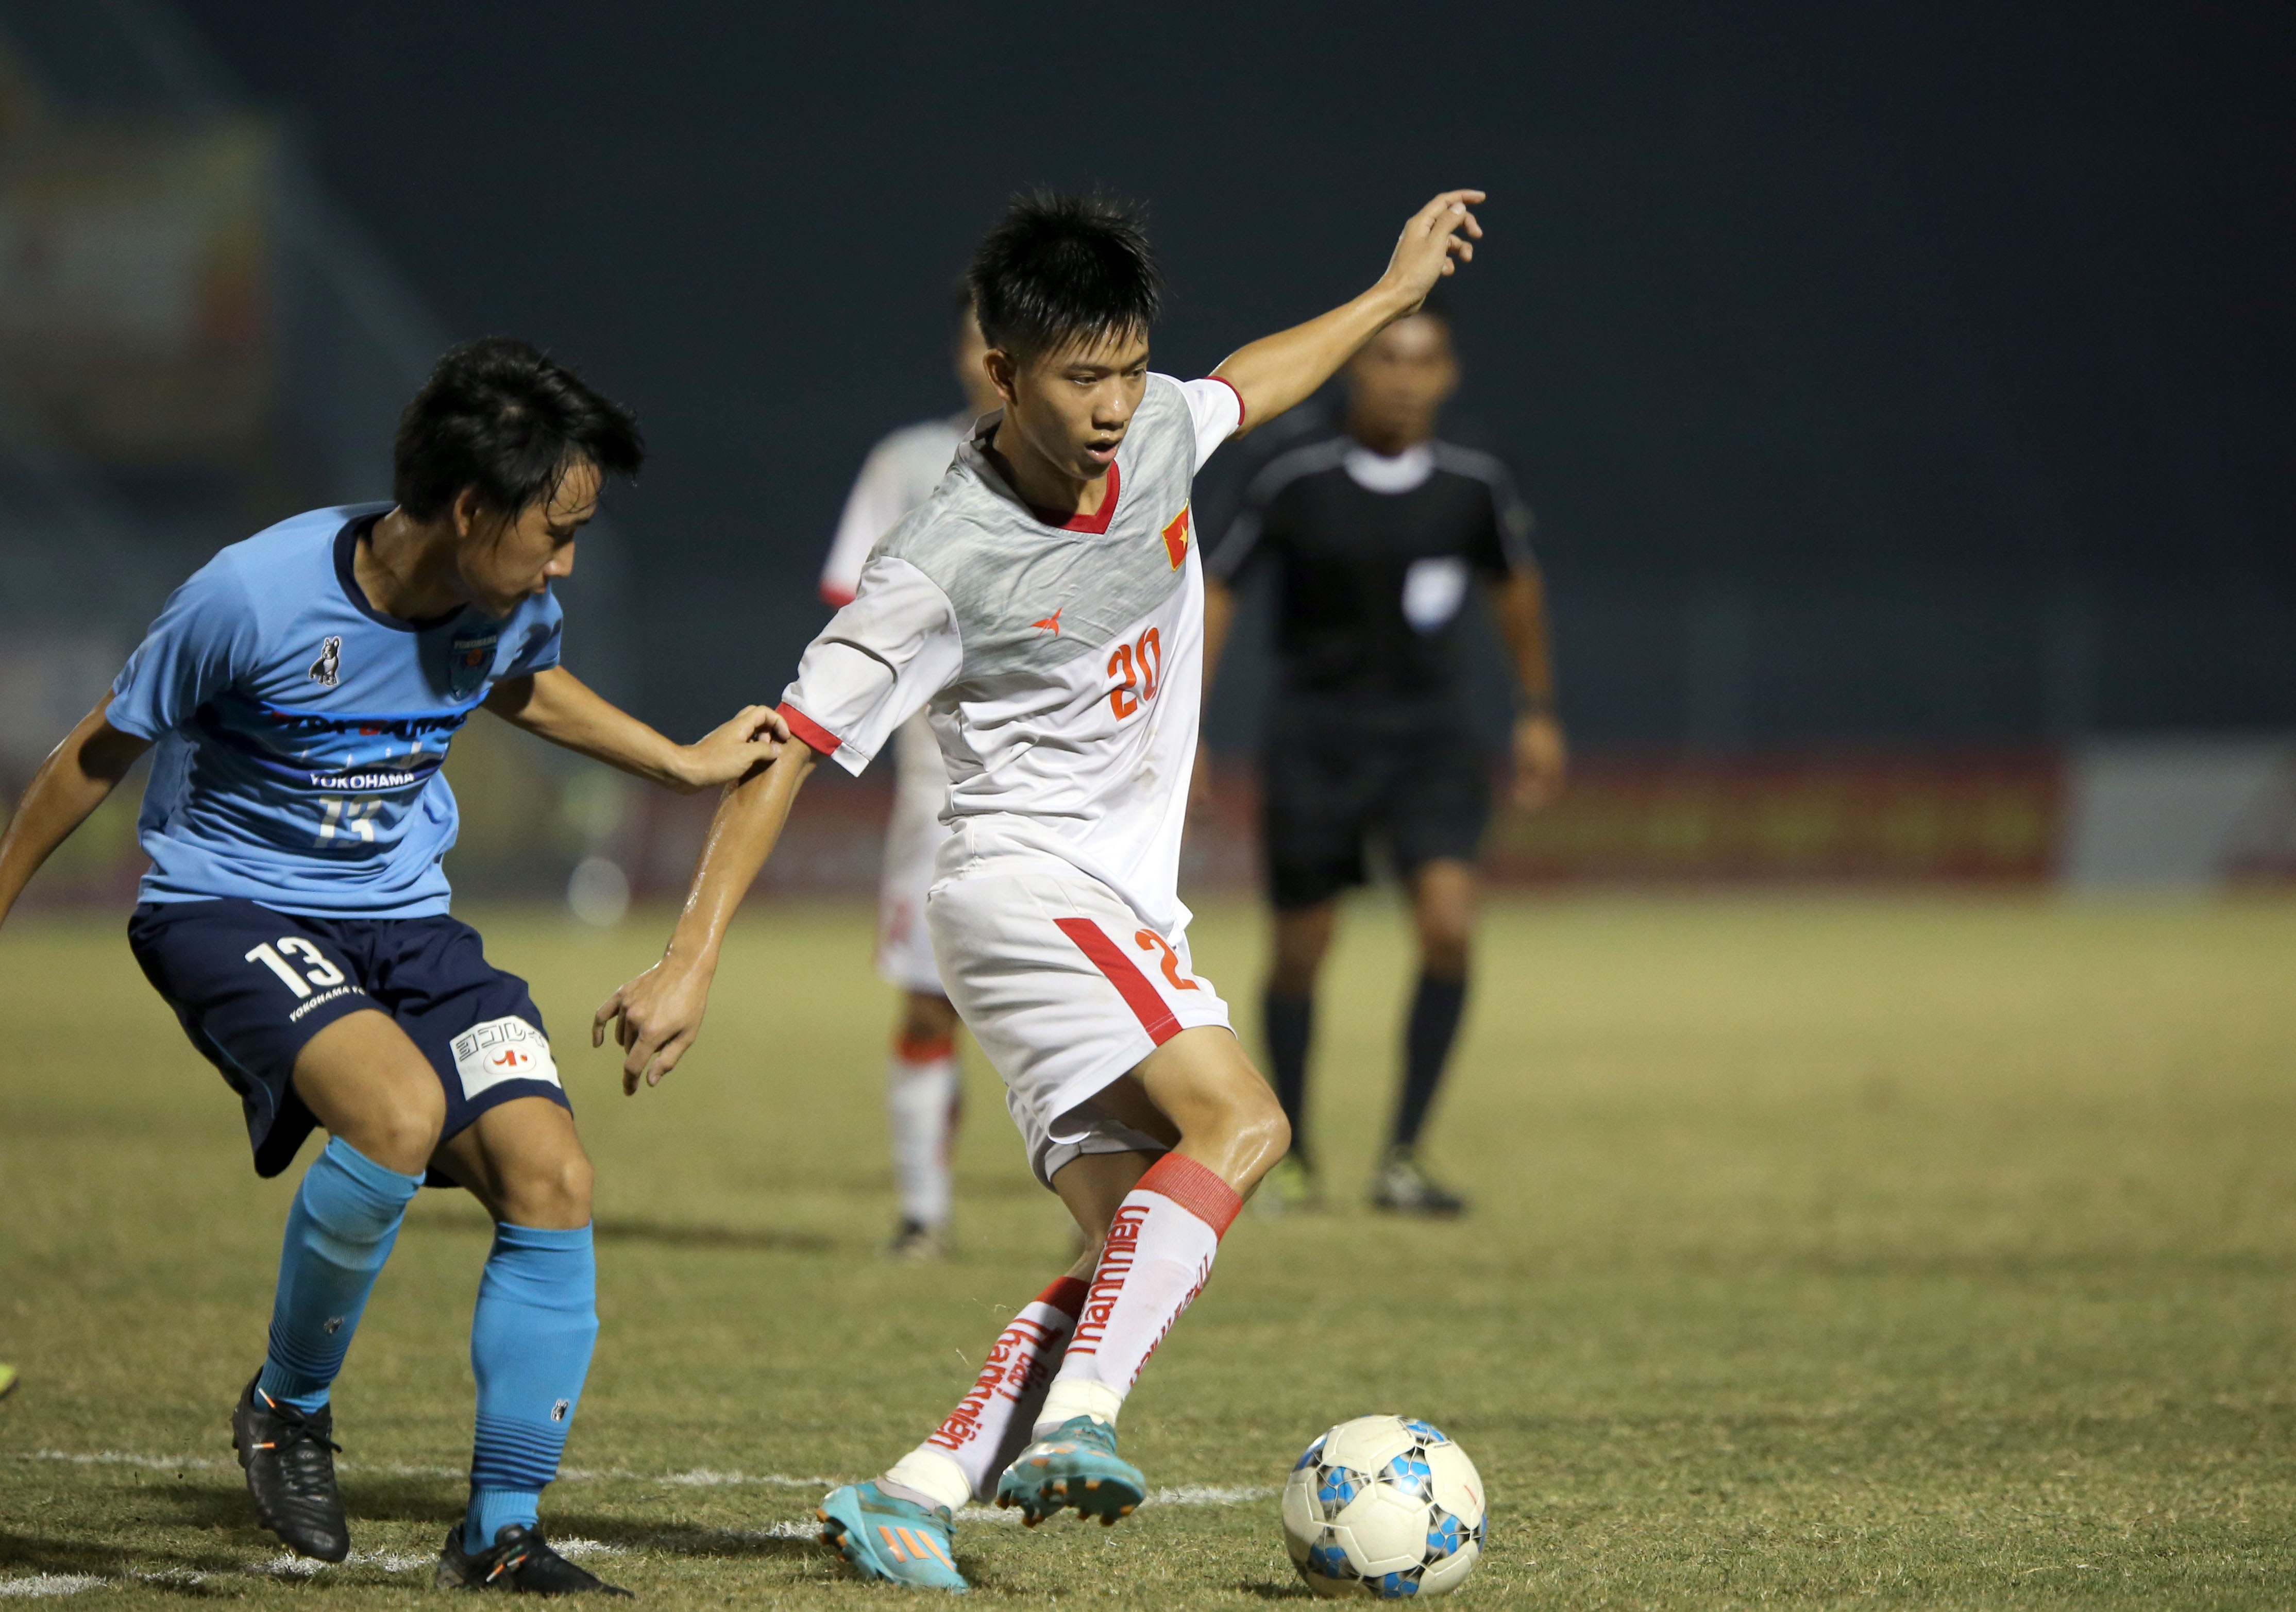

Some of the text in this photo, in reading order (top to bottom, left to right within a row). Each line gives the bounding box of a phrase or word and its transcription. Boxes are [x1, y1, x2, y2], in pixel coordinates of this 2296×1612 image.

[1107, 626, 1161, 722] 20
[310, 773, 415, 789] YOKOHAMA
[313, 794, 382, 849] 13
[245, 937, 345, 998] 13
[289, 986, 349, 1023] YOKOHAMA
